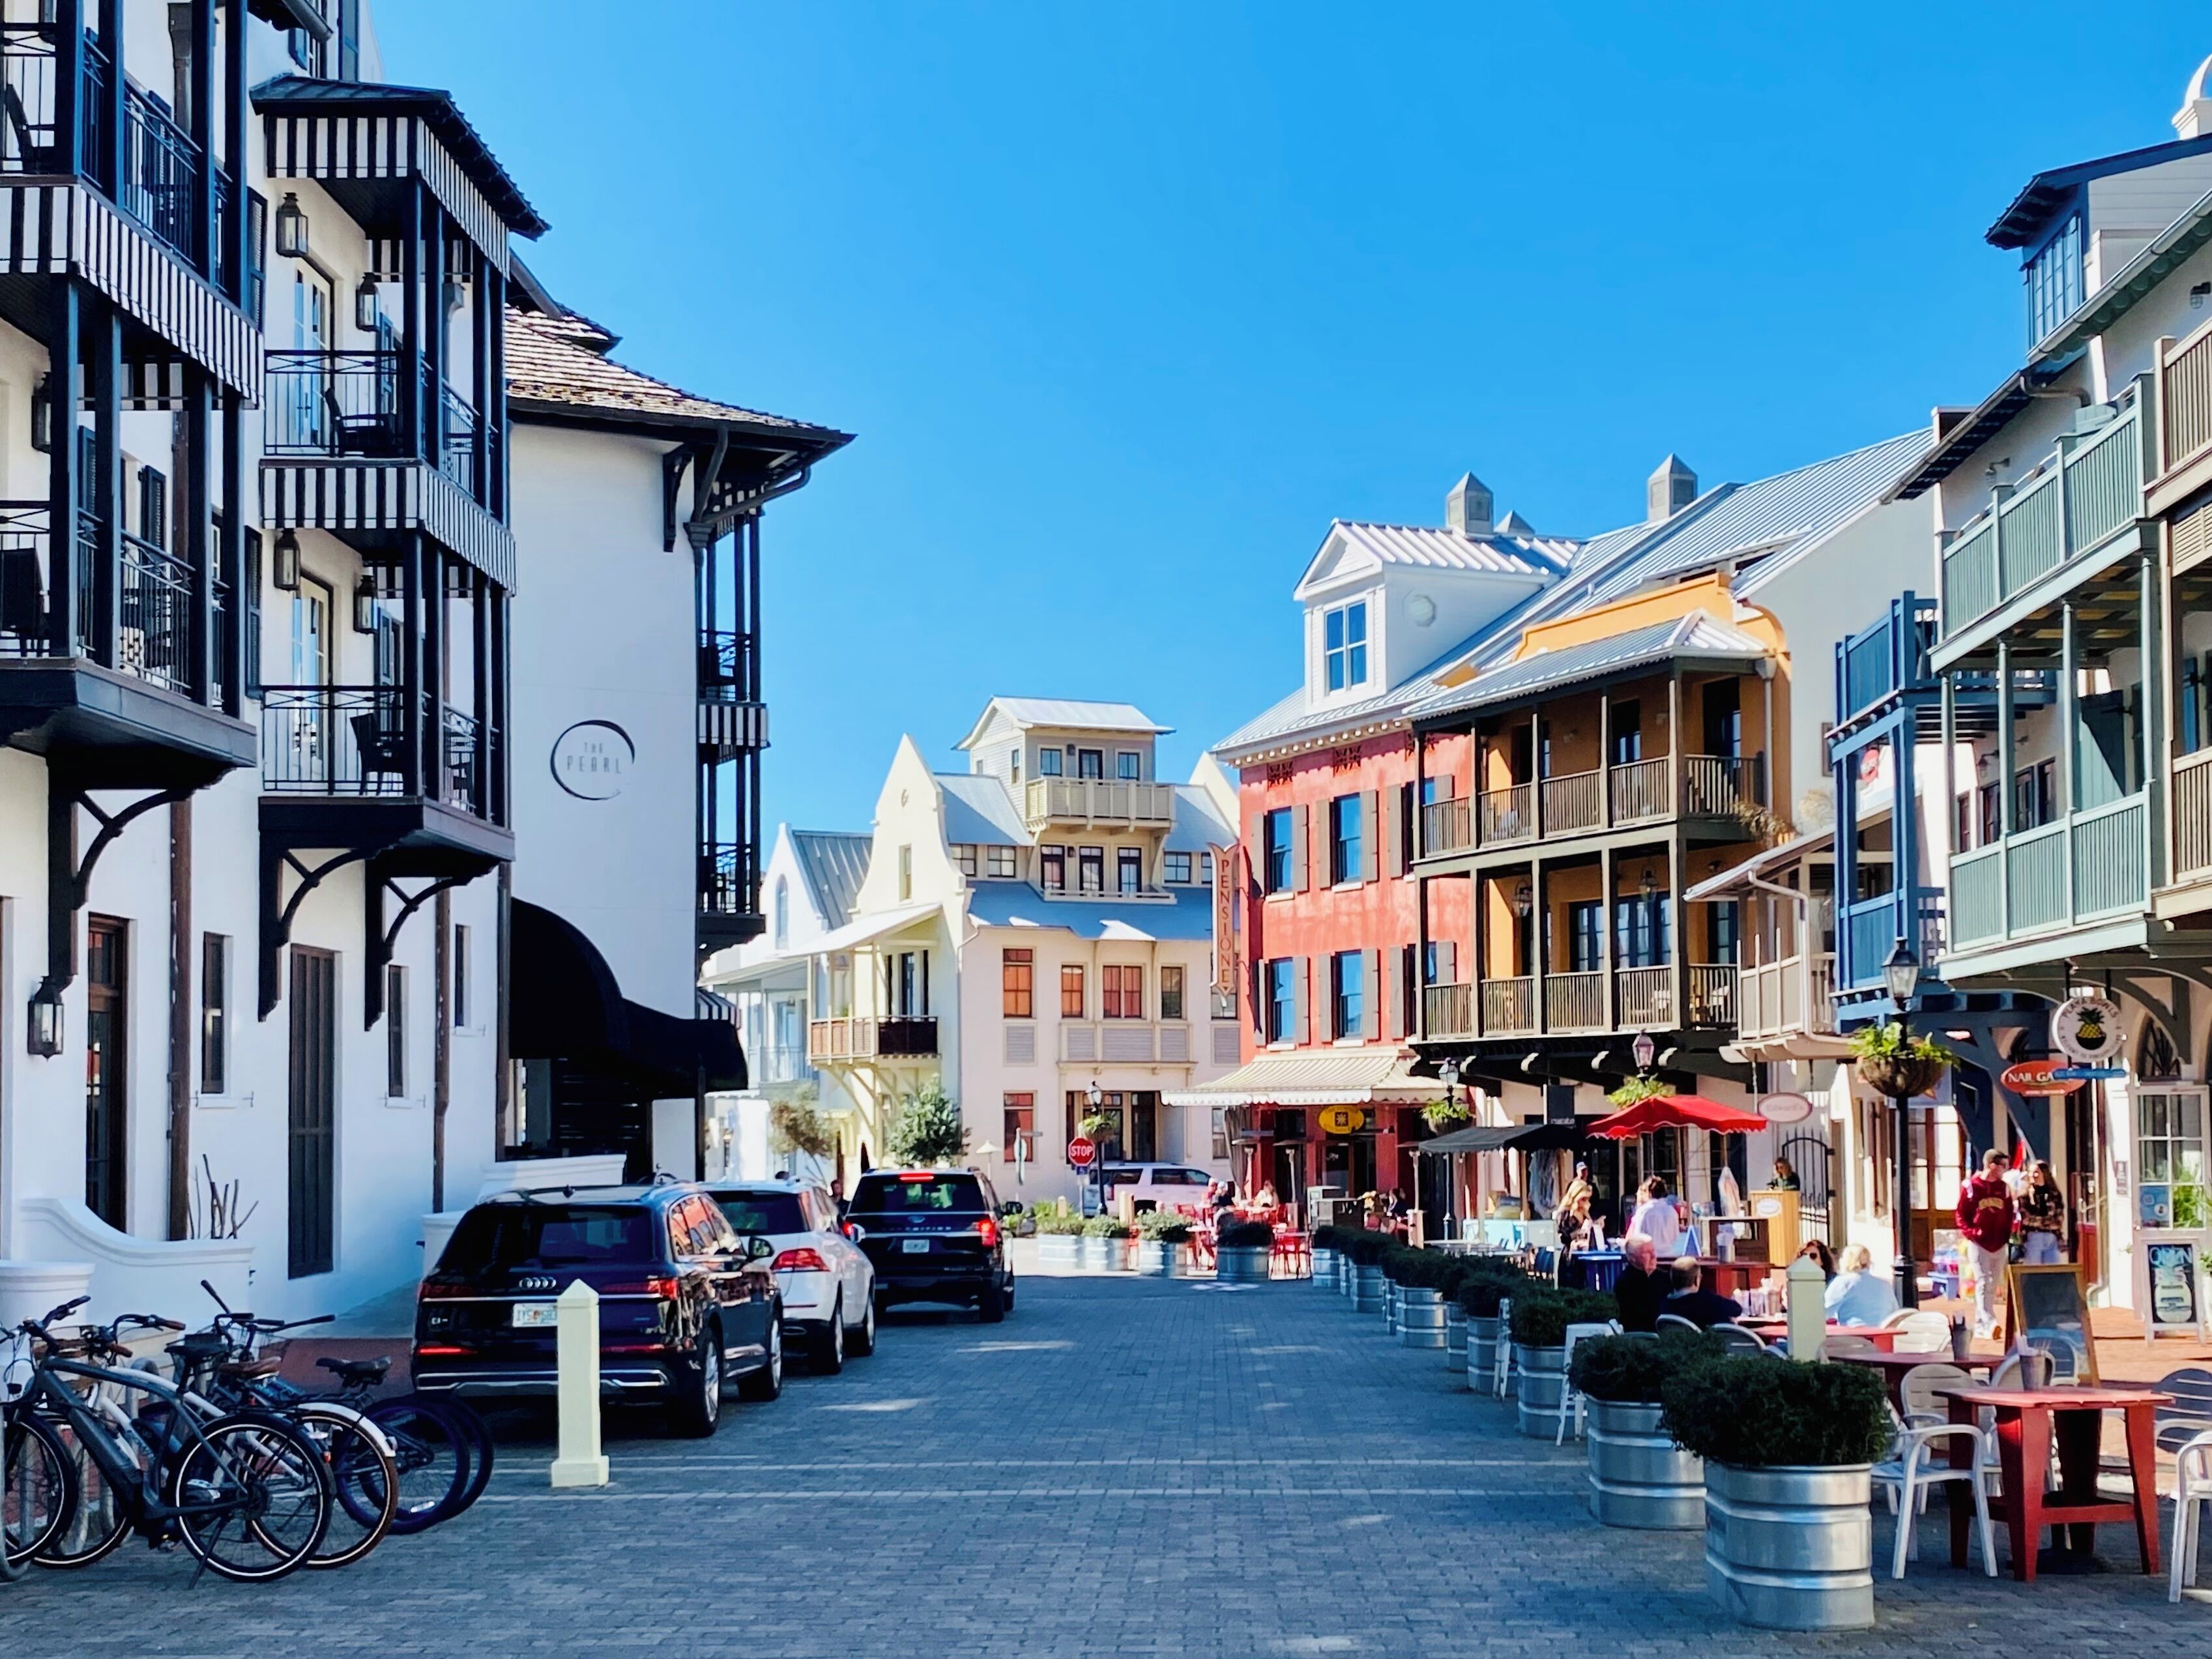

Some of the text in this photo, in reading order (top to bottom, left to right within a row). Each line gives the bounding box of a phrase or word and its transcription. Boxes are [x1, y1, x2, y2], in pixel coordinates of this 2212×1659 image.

[584, 742, 604, 754] THE
[566, 755, 622, 775] PEARL
[1219, 859, 1232, 983] PENSIONE
[2008, 1072, 2033, 1083] NAIL
[1071, 1145, 1094, 1157] STOP
